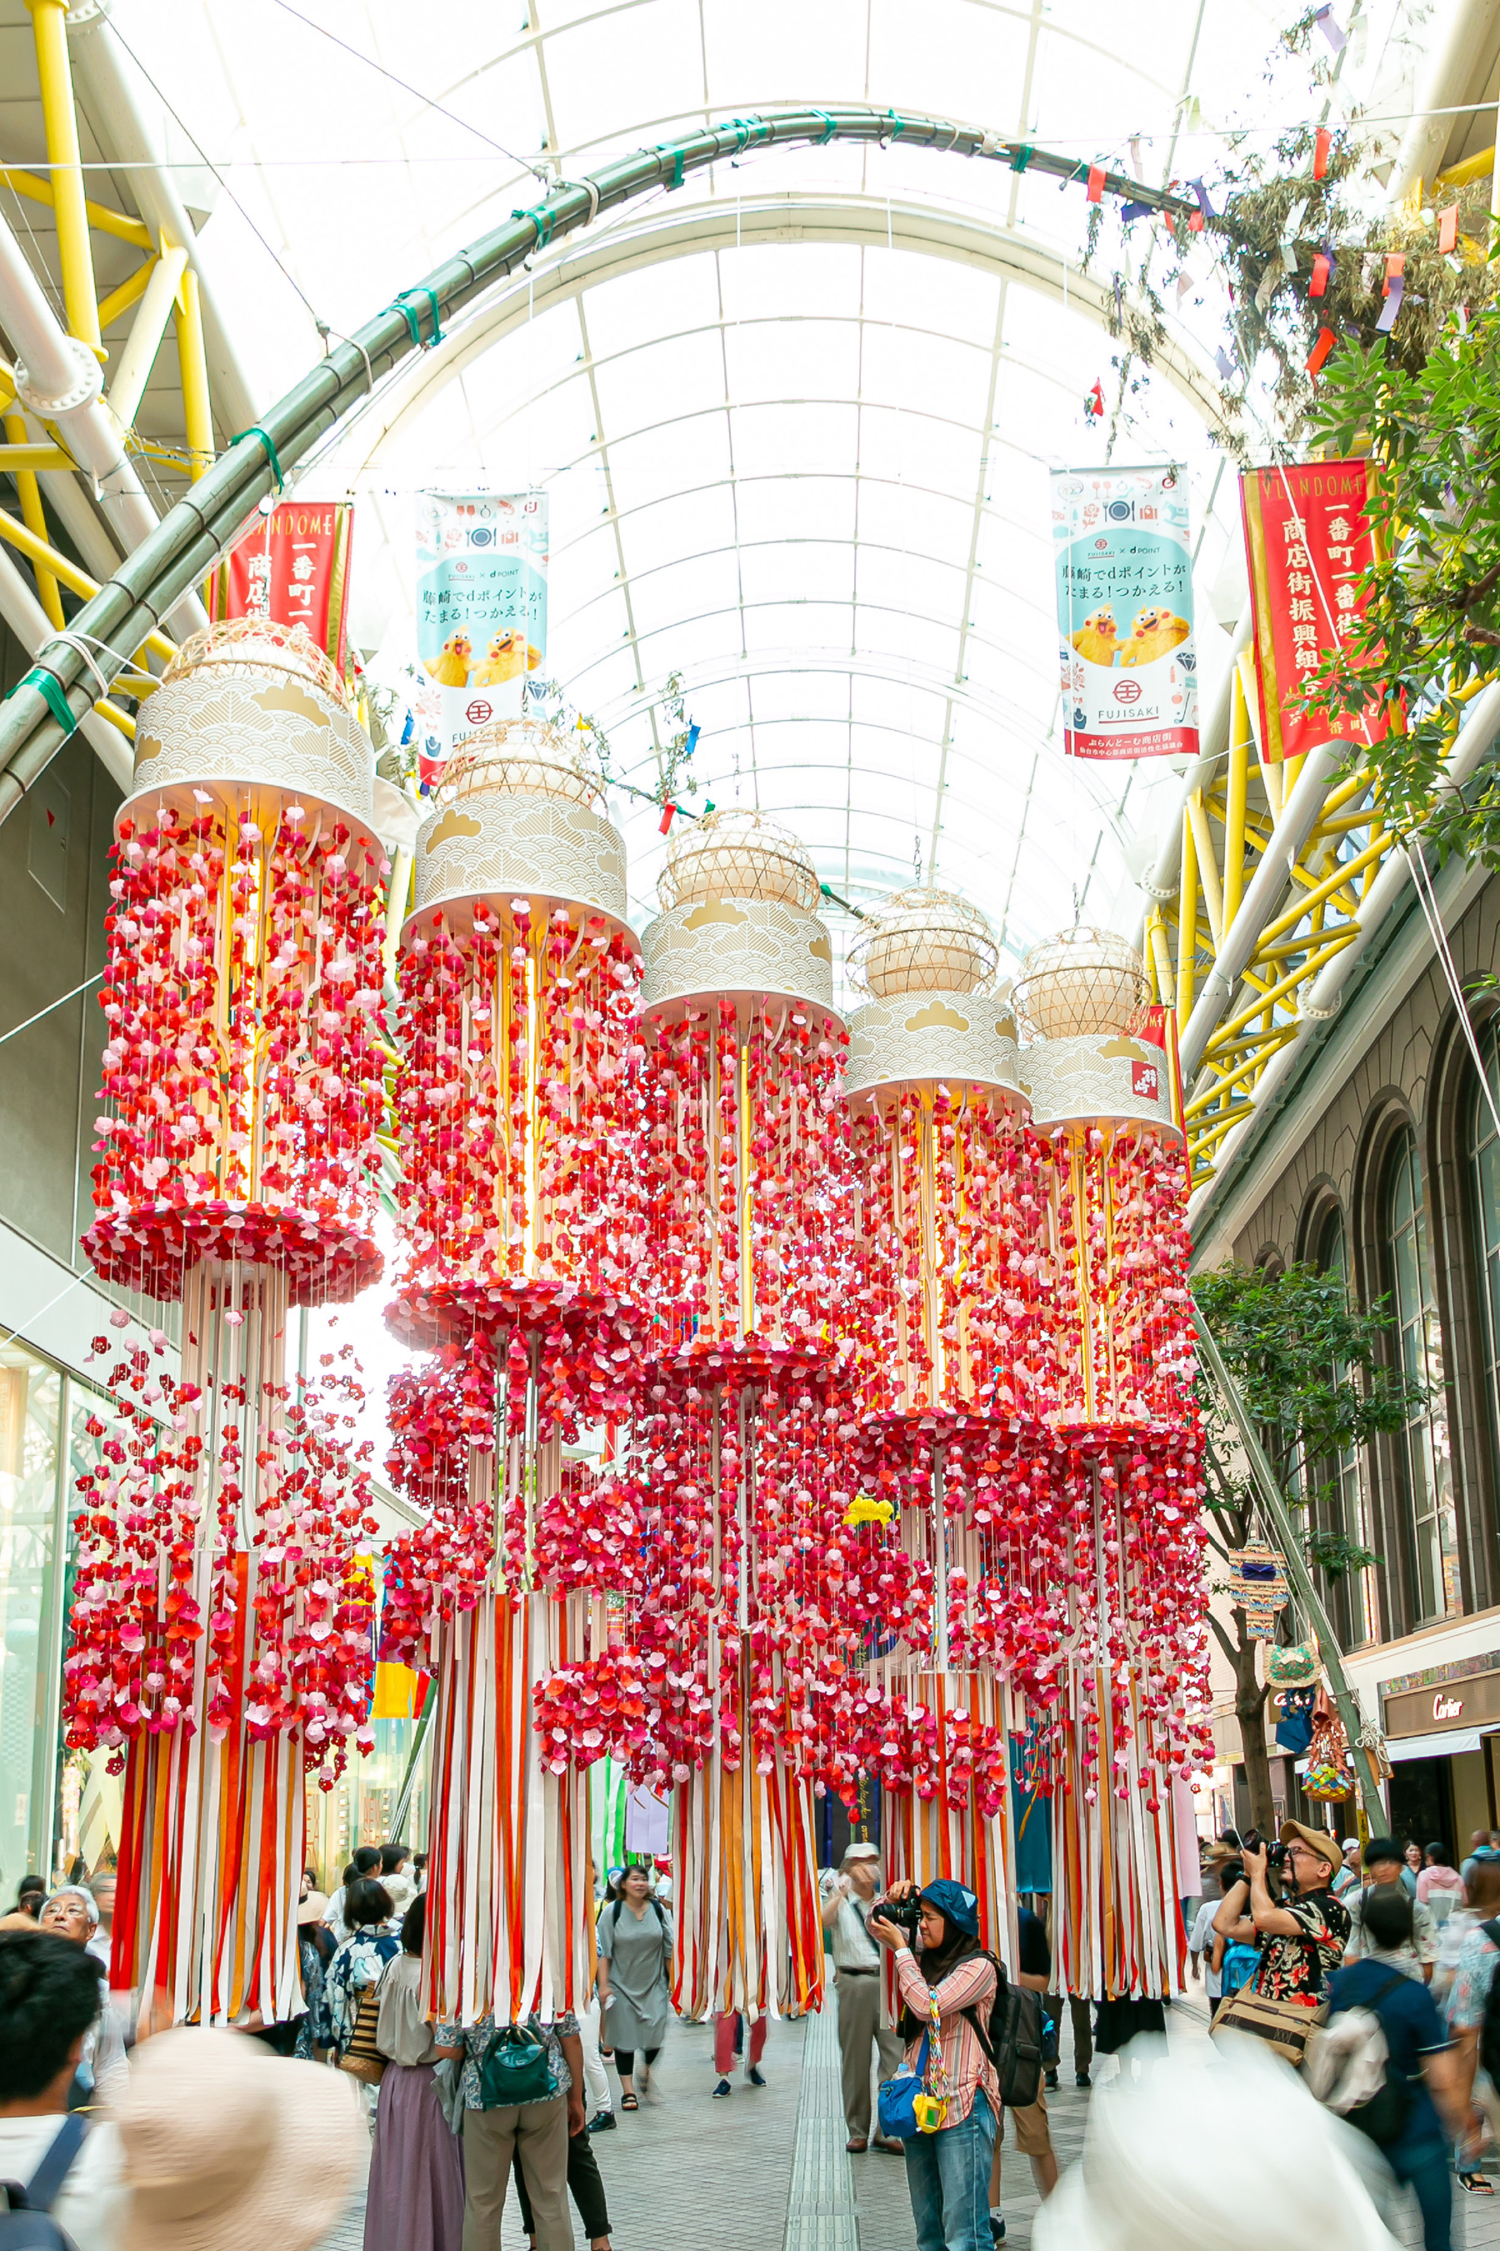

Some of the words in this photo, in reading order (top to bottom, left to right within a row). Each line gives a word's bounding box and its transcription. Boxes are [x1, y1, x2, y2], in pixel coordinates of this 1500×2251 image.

[1062, 564, 1186, 581] 藤崎でdポイントが
[1098, 706, 1159, 719] FUJISAKI
[1433, 1693, 1464, 1721] Cartier
